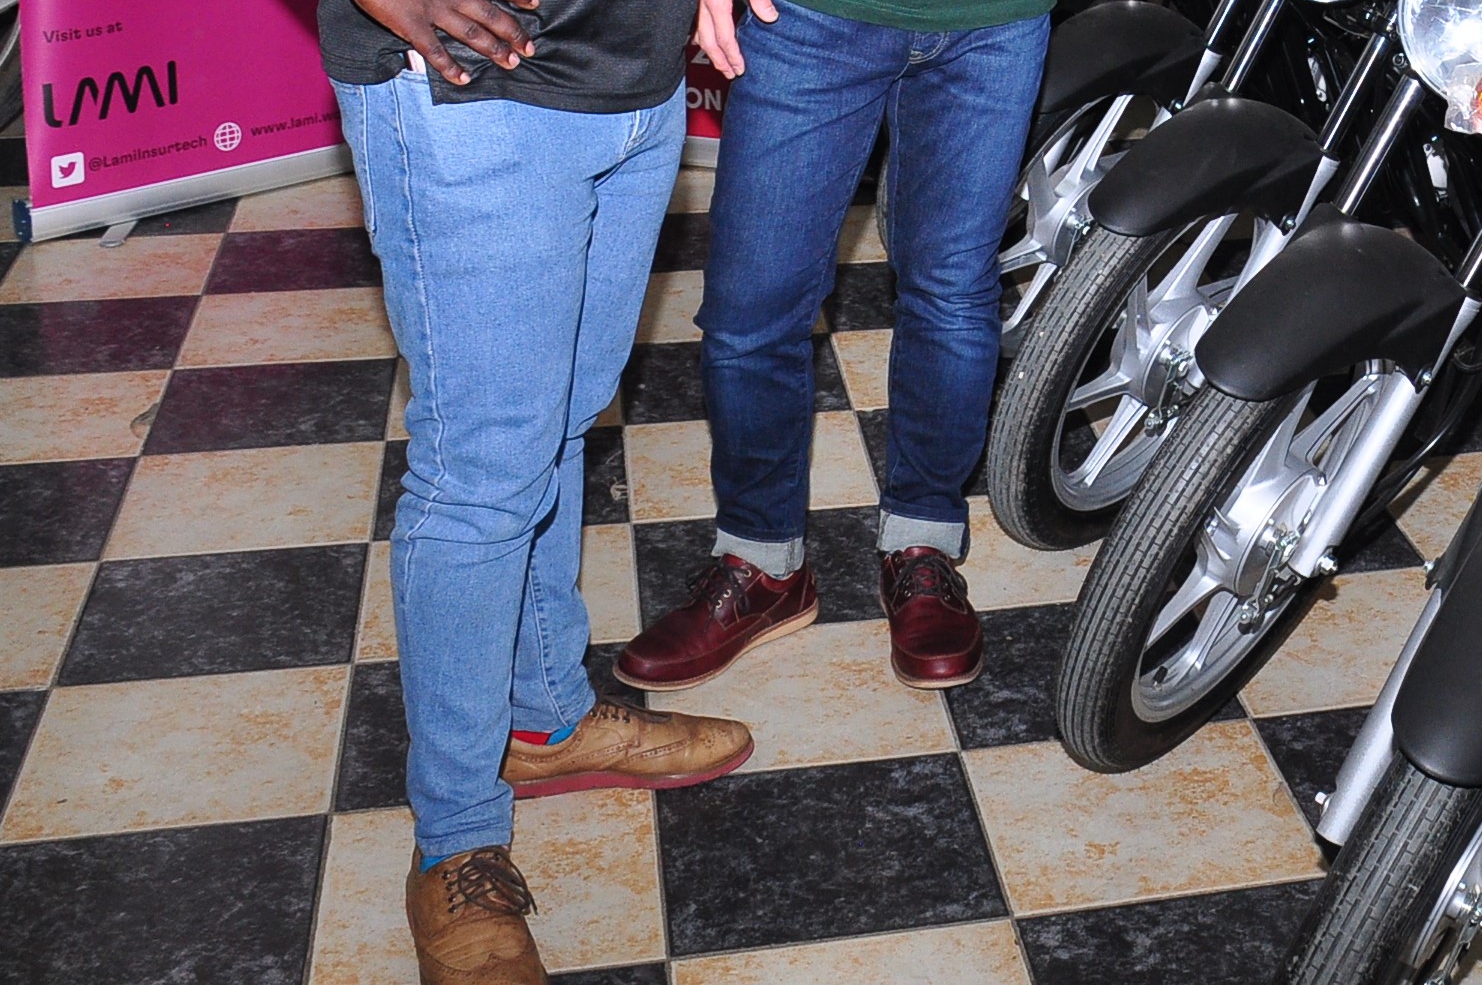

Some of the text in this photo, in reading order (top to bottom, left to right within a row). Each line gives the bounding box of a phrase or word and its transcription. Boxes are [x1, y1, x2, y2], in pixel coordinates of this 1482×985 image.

[43, 21, 123, 44] Visit us at
[42, 60, 178, 128] LAMI
[88, 135, 208, 172] @LamiInsurtech
